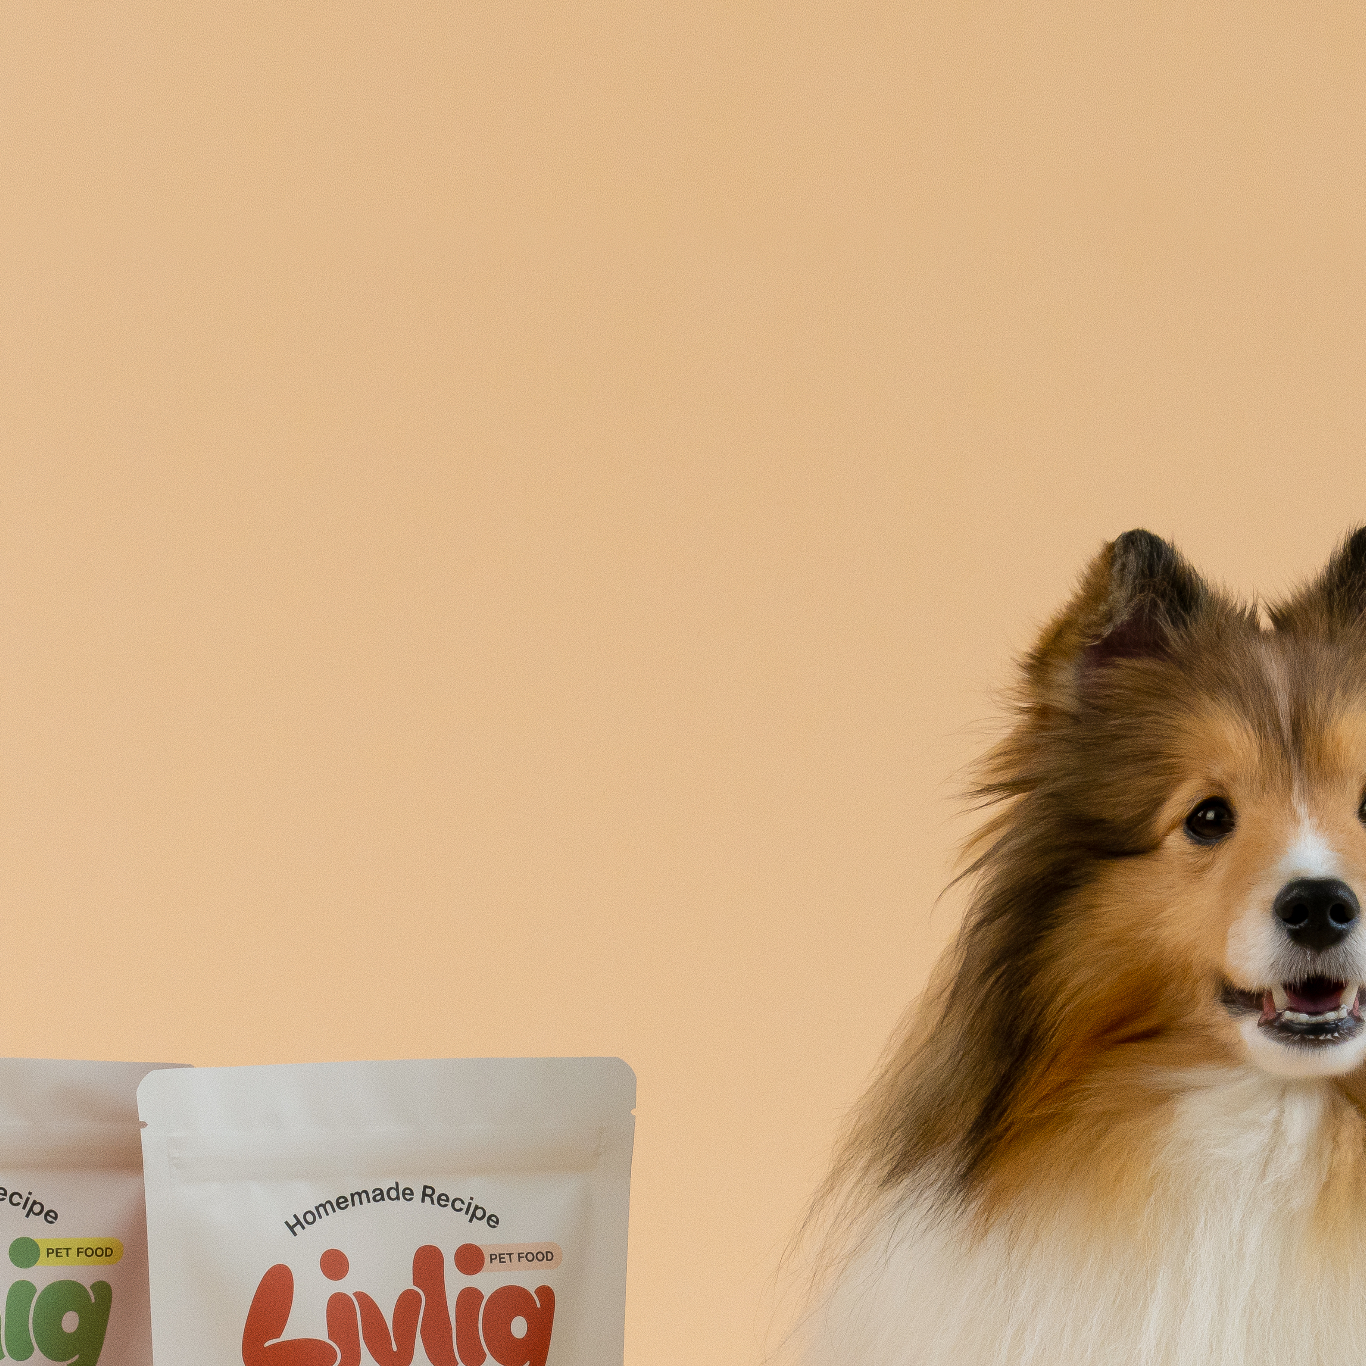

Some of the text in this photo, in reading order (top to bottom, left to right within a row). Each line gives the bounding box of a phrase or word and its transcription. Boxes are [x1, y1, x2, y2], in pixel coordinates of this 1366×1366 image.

[284, 1181, 500, 1237] Homemade Recipe
[45, 1246, 114, 1259] PET FOOD
[489, 1250, 554, 1265] PET FOOD
